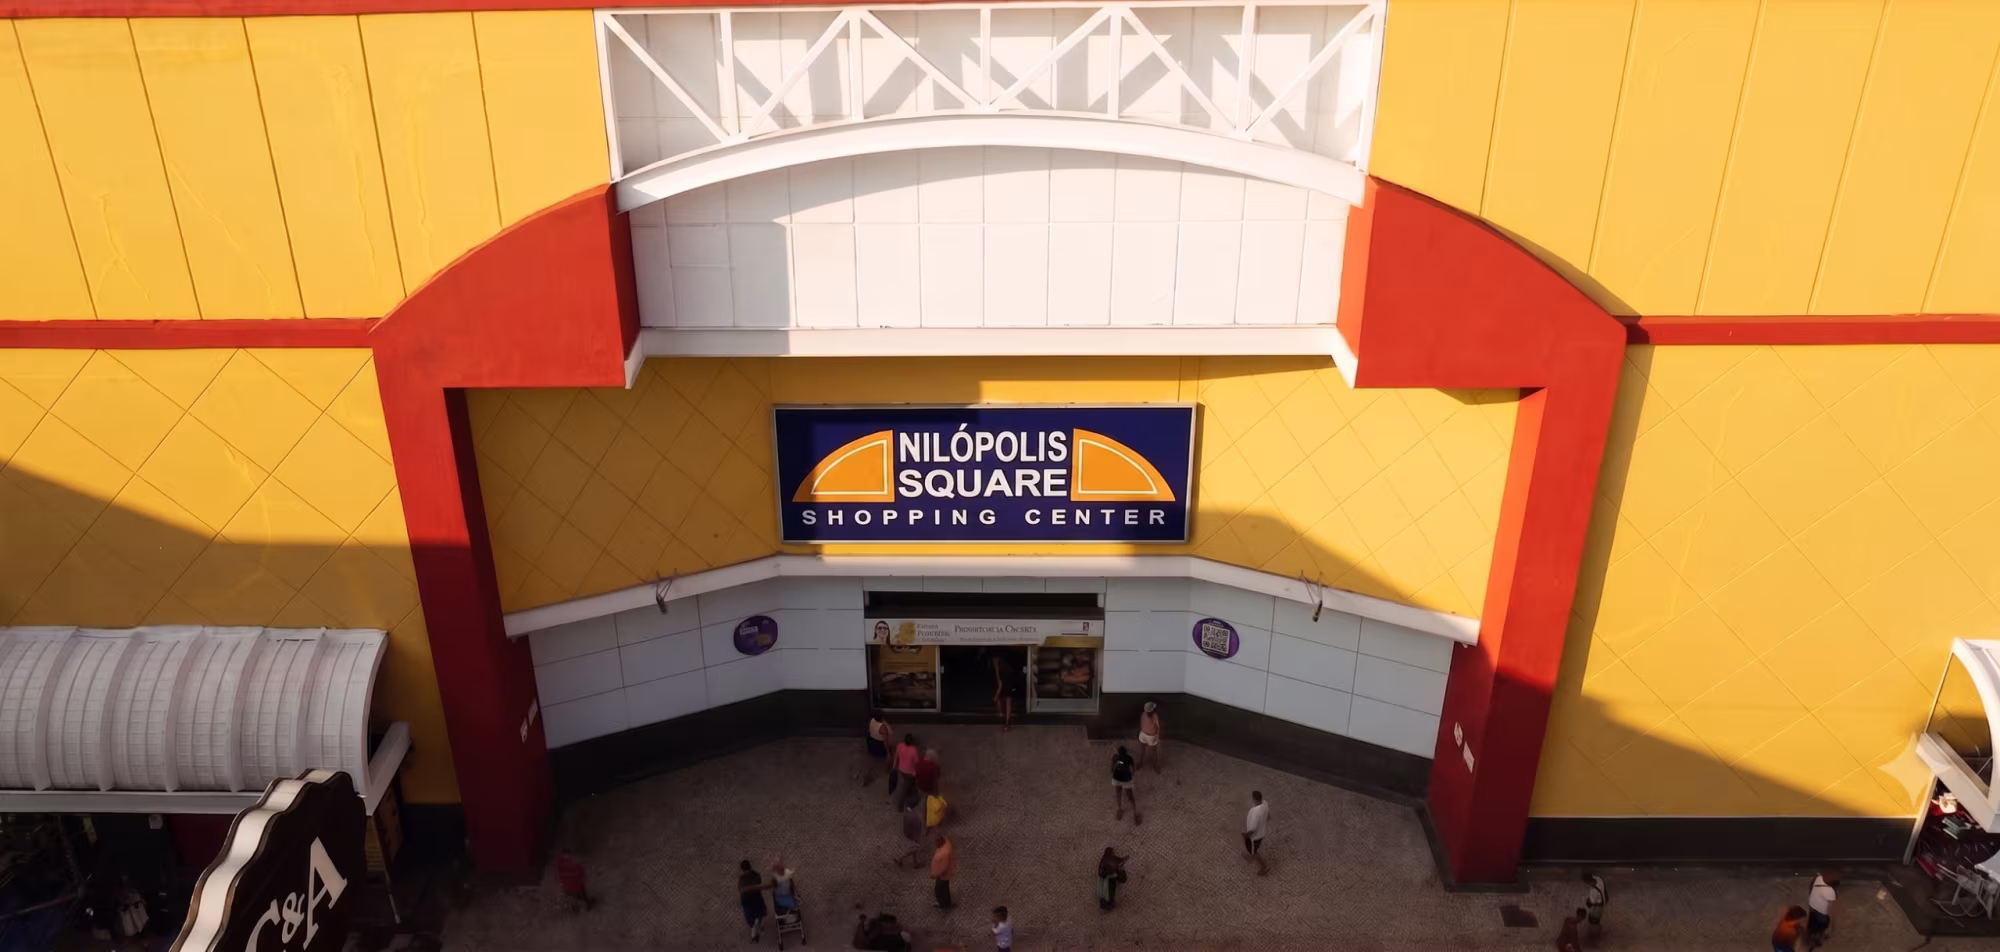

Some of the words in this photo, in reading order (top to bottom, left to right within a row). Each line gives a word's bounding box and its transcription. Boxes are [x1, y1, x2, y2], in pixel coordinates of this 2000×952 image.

[899, 423, 1068, 463] NILÓPOLIS
[898, 468, 1068, 499] SQUARE
[801, 508, 996, 526] SHOPPING
[1024, 508, 1166, 526] CENTER
